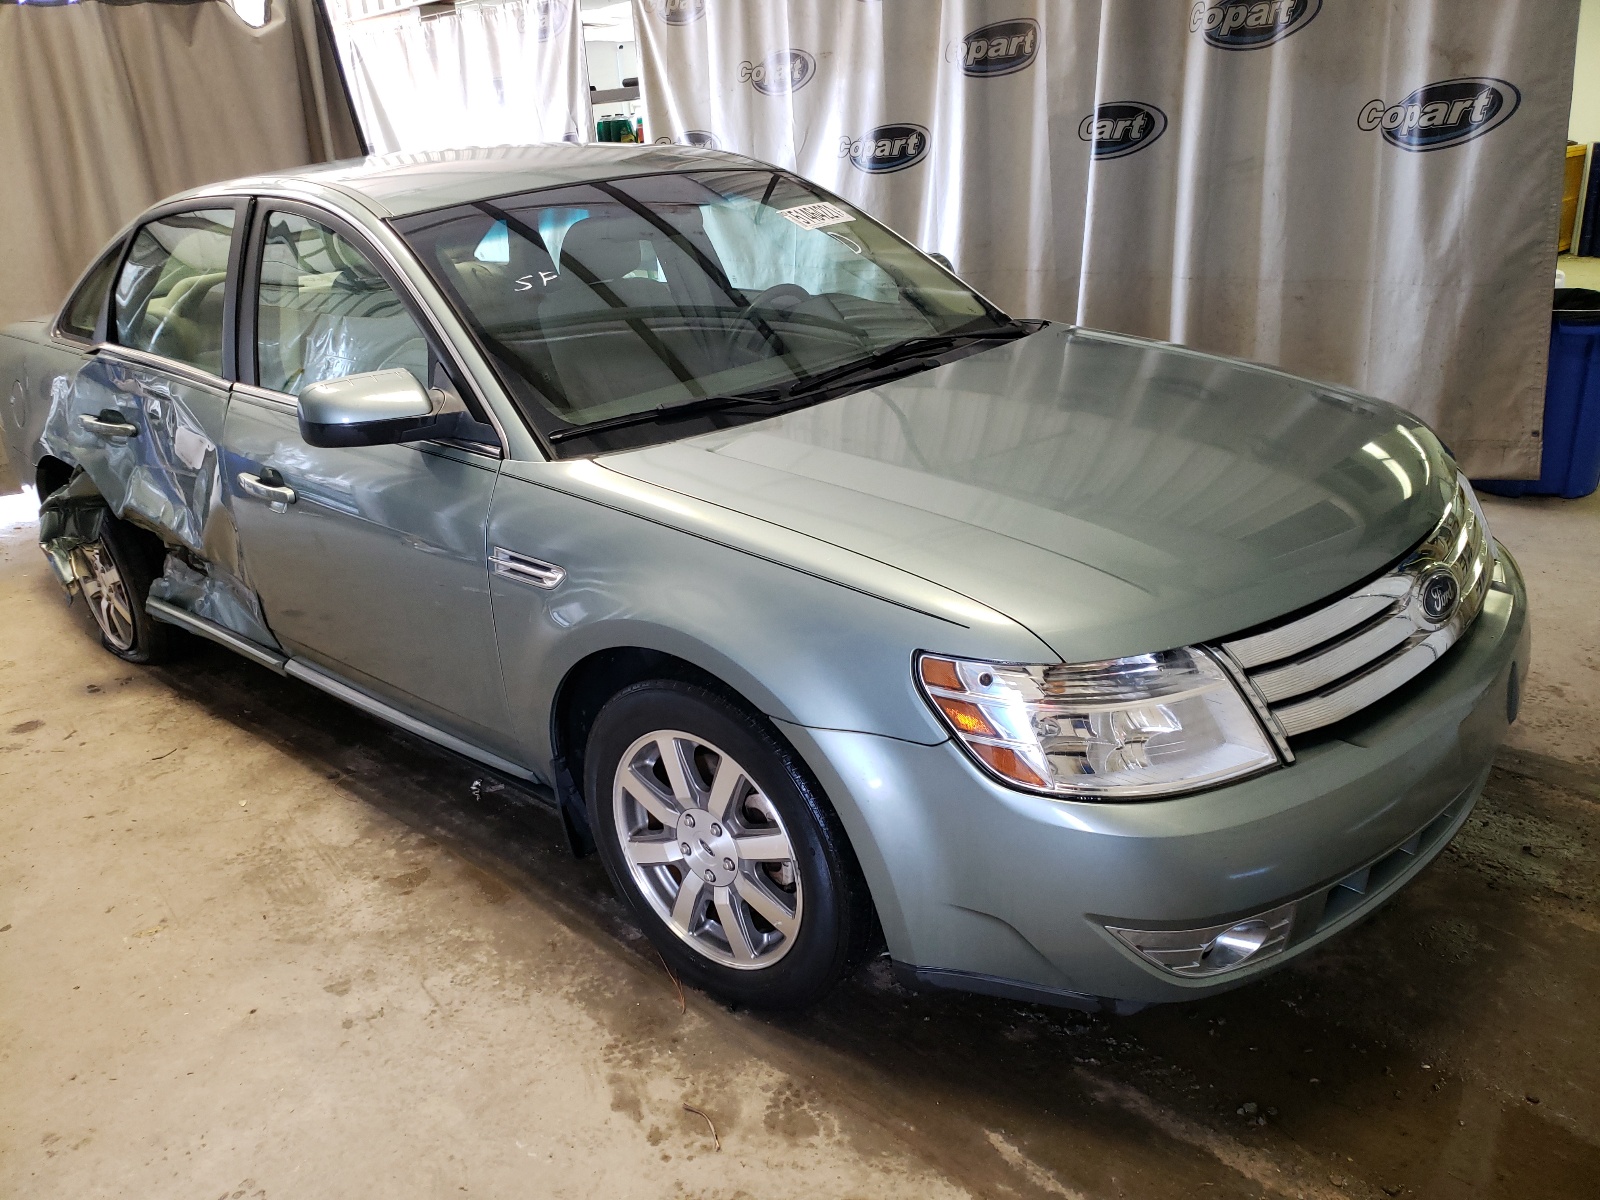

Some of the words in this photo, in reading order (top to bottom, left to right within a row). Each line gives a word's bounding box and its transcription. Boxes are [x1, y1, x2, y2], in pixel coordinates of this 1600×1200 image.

[1357, 87, 1494, 137] Copart
[838, 131, 920, 164] Copart
[1430, 581, 1453, 612] Ford
